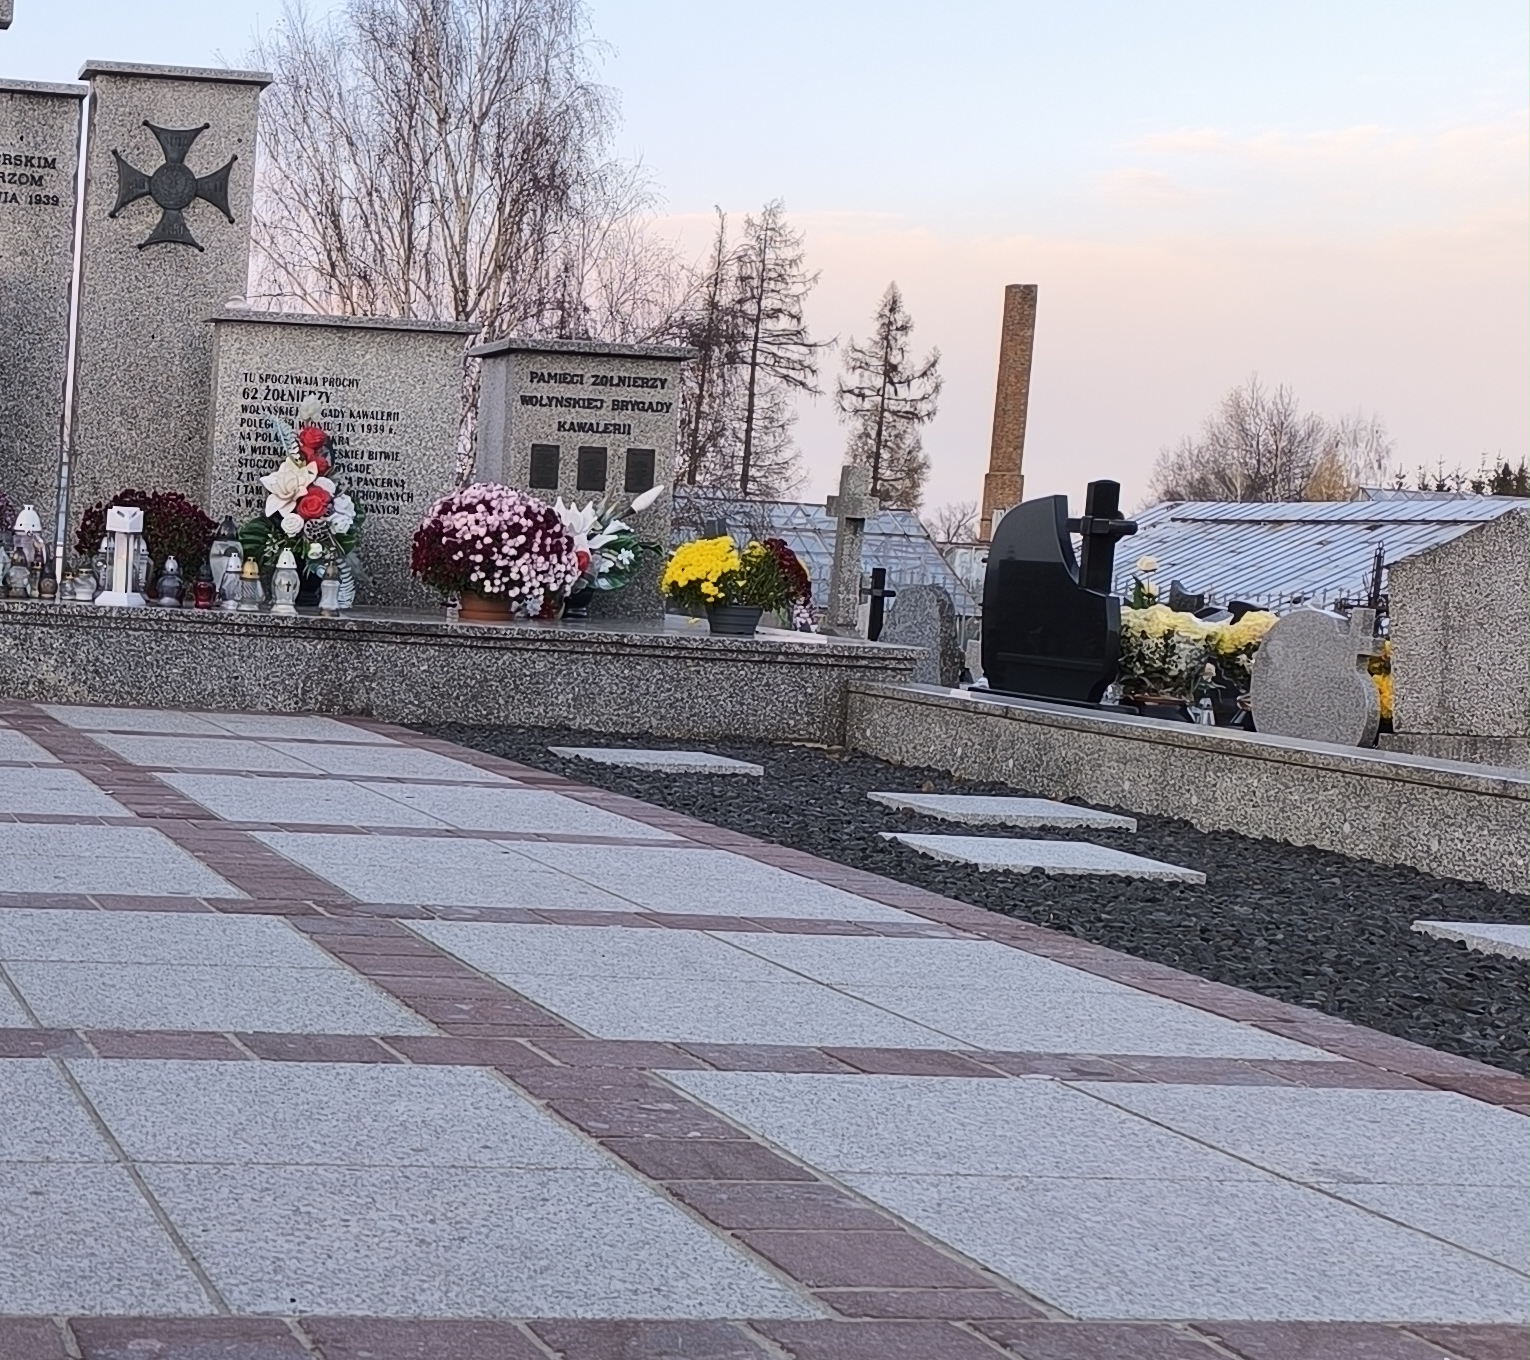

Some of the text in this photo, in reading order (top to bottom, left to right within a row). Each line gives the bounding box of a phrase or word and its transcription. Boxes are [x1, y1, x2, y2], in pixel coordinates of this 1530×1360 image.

[28, 193, 60, 206] 1939
[244, 373, 255, 383] TU
[322, 376, 361, 388] PROCHY
[242, 388, 258, 400] 62
[611, 399, 673, 413] BRYGADY
[349, 409, 400, 422] KAWALERII
[347, 422, 356, 433] IX
[361, 423, 385, 434] 1939
[557, 421, 632, 435] KAWALERII
[368, 450, 401, 462] BITWIE
